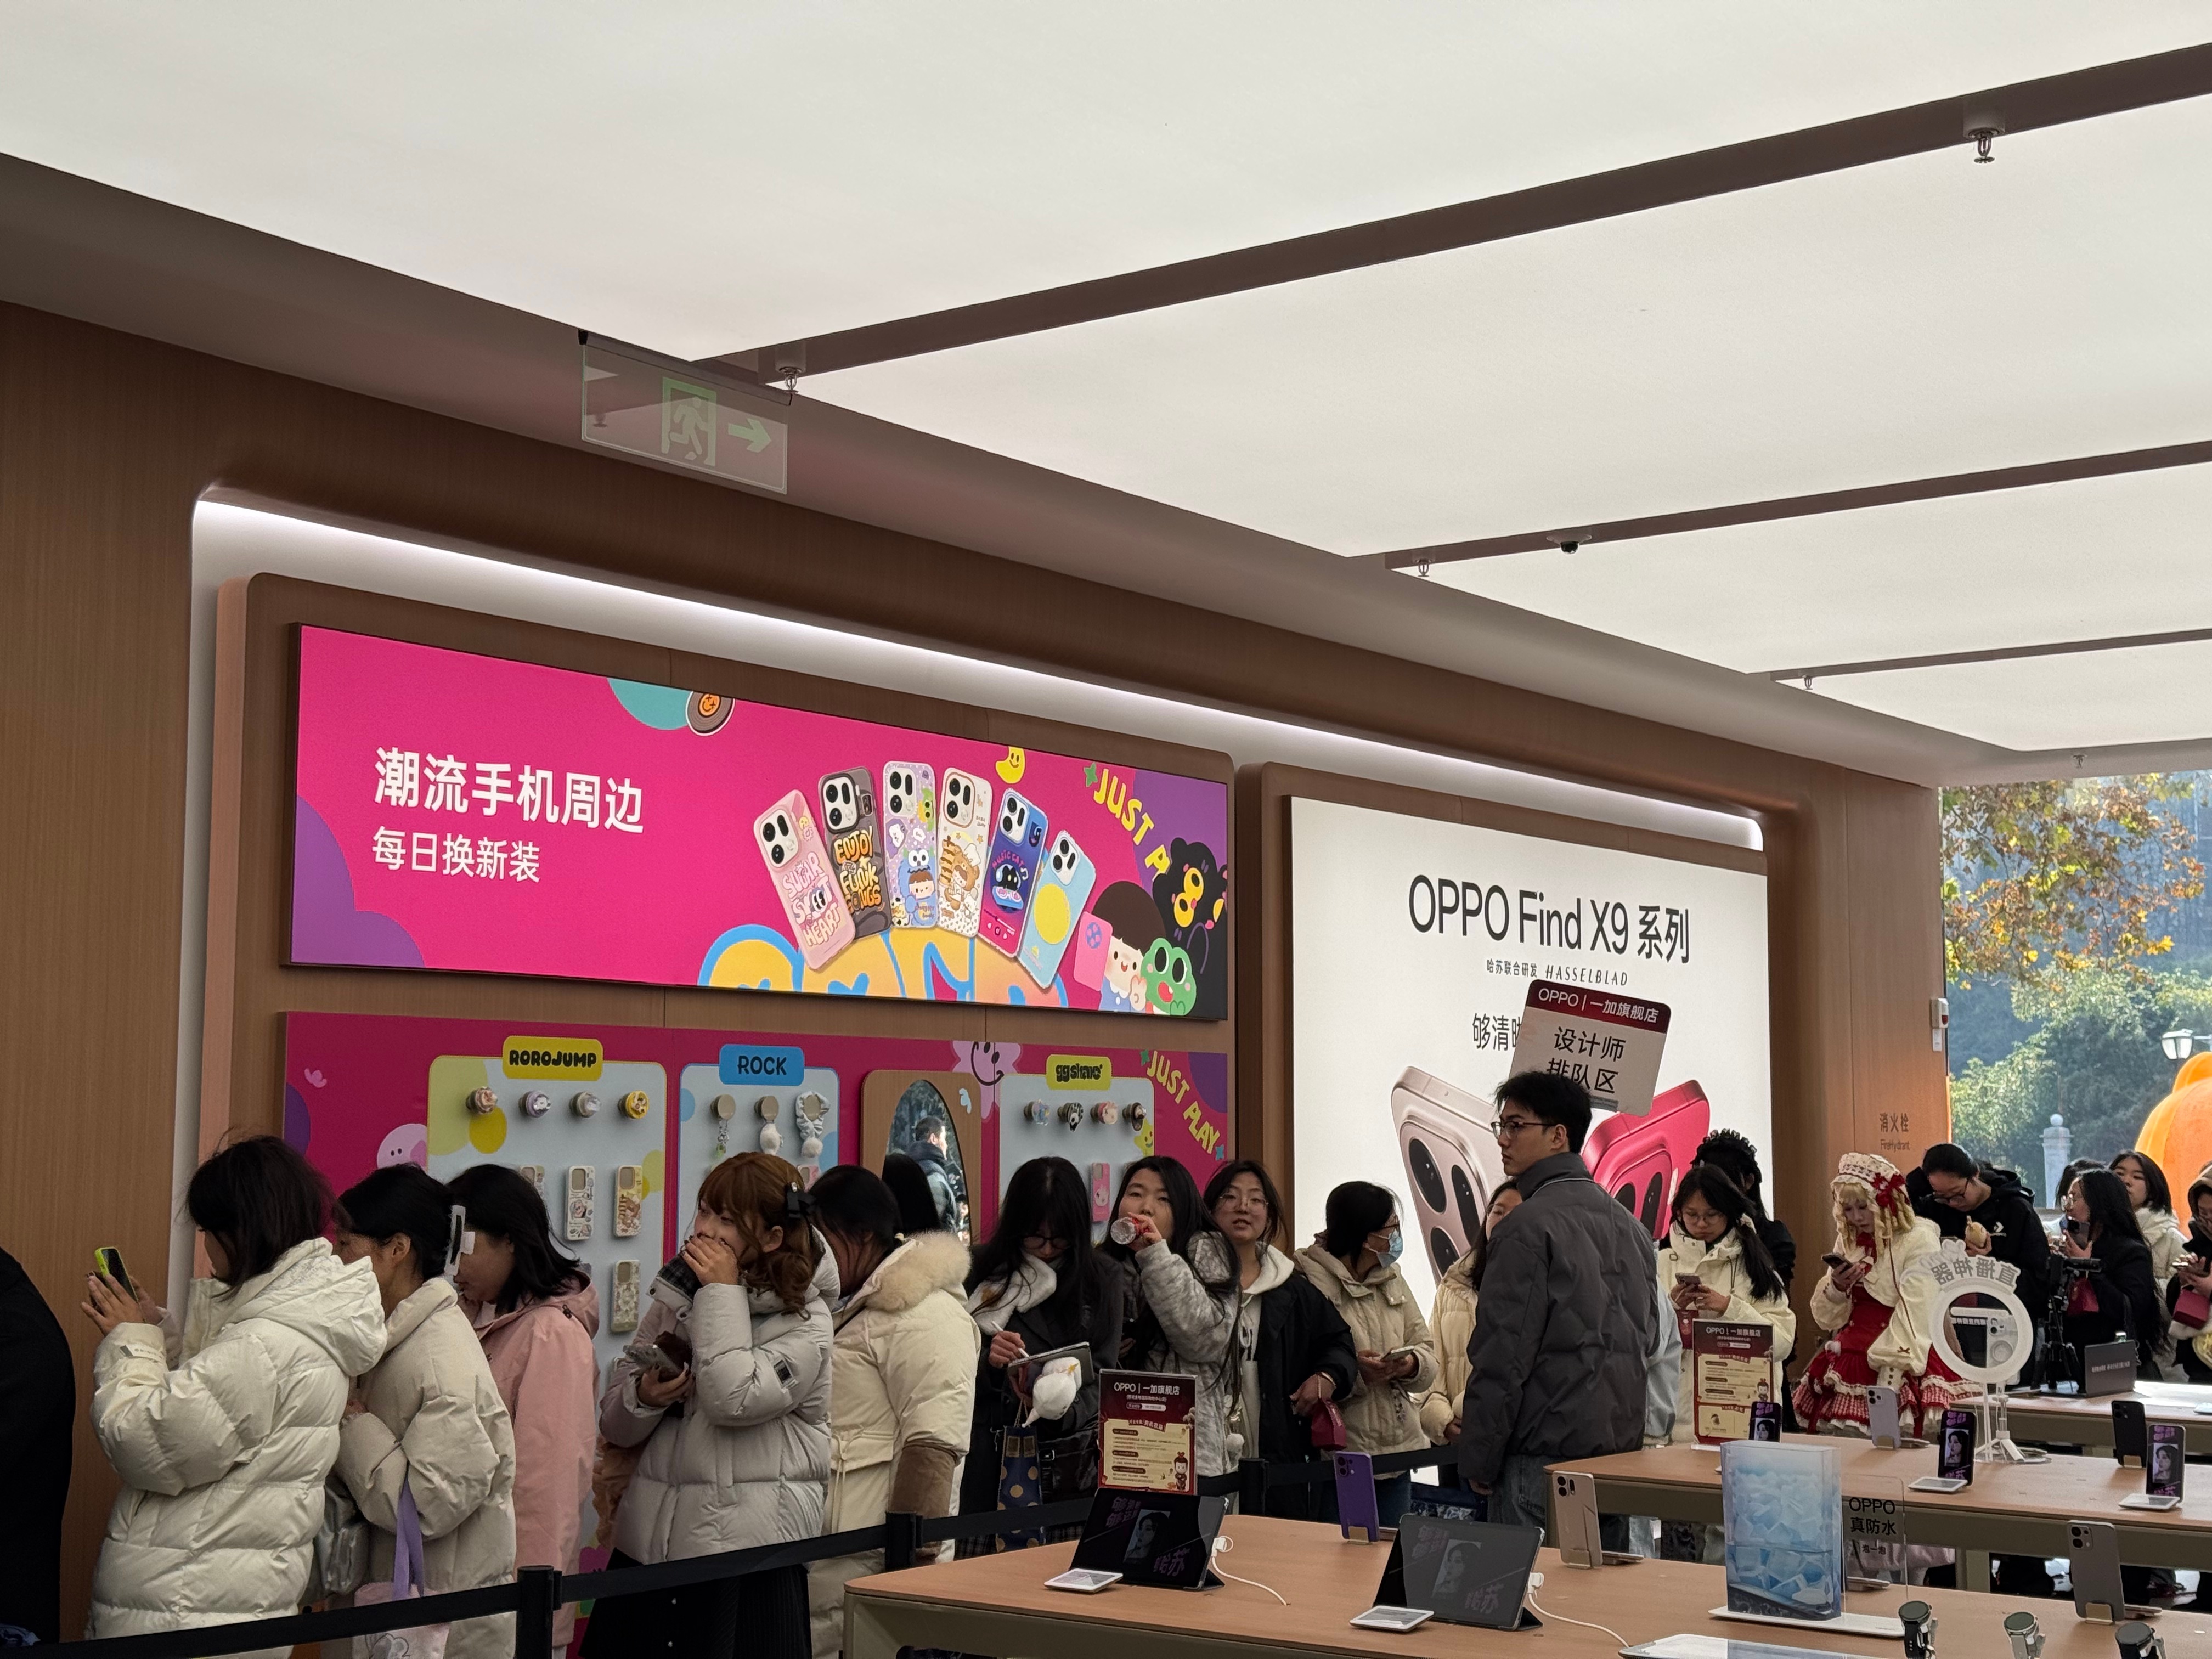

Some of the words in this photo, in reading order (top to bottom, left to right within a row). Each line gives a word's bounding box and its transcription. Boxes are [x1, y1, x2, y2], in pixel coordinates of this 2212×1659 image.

[374, 747, 644, 834] 潮流手机周边
[1093, 769, 1154, 845] JUST
[371, 826, 541, 883] 每日换新装
[834, 826, 873, 864] ENJOY
[992, 850, 1011, 869] MUSIC
[1011, 852, 1025, 868] CAT
[782, 851, 825, 900] SUGAR
[840, 862, 879, 894] FUNK
[803, 903, 840, 947] HEART
[1409, 875, 1509, 941] OPPO
[1519, 889, 1582, 950] Find
[1589, 899, 1629, 955] X9
[1637, 905, 1689, 964] 系列
[1487, 959, 1537, 978] 哈苏联合研发
[1545, 964, 1628, 986] HASSELBLAD
[1538, 988, 1579, 1007] OPPO
[1590, 1000, 1660, 1023] 一加旗舰店
[509, 1049, 597, 1068] ROROJUMP
[1554, 1026, 1626, 1062] 设计师
[737, 1055, 787, 1075] ROCK
[1147, 1050, 1190, 1104] JUST
[1183, 1101, 1220, 1154] PLAY
[1880, 1113, 1909, 1132] 消火栓
[1706, 1327, 1724, 1335] OPPO
[1114, 1382, 1136, 1392] OPPO
[1849, 1497, 1895, 1514] OPPO
[1850, 1517, 1897, 1536] 真防水
[1862, 1544, 1886, 1555] 泡一泡
